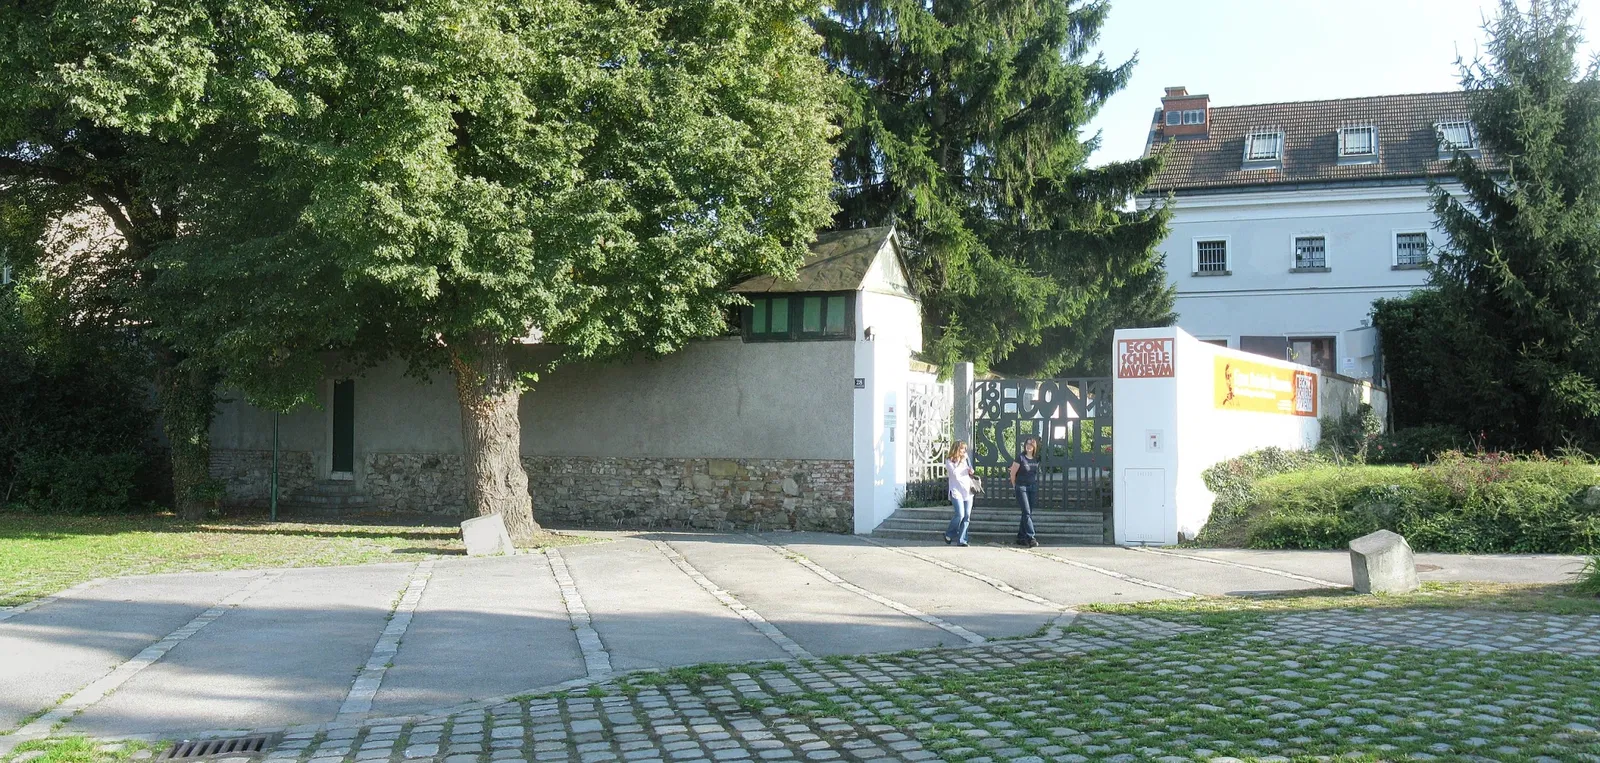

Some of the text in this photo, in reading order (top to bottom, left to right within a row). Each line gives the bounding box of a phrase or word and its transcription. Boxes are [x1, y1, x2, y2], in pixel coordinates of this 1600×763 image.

[1121, 352, 1170, 365] SCHIELE
[1126, 340, 1164, 353] EGON
[1001, 380, 1085, 419] EGON
[974, 420, 1112, 466] SCHIELE
